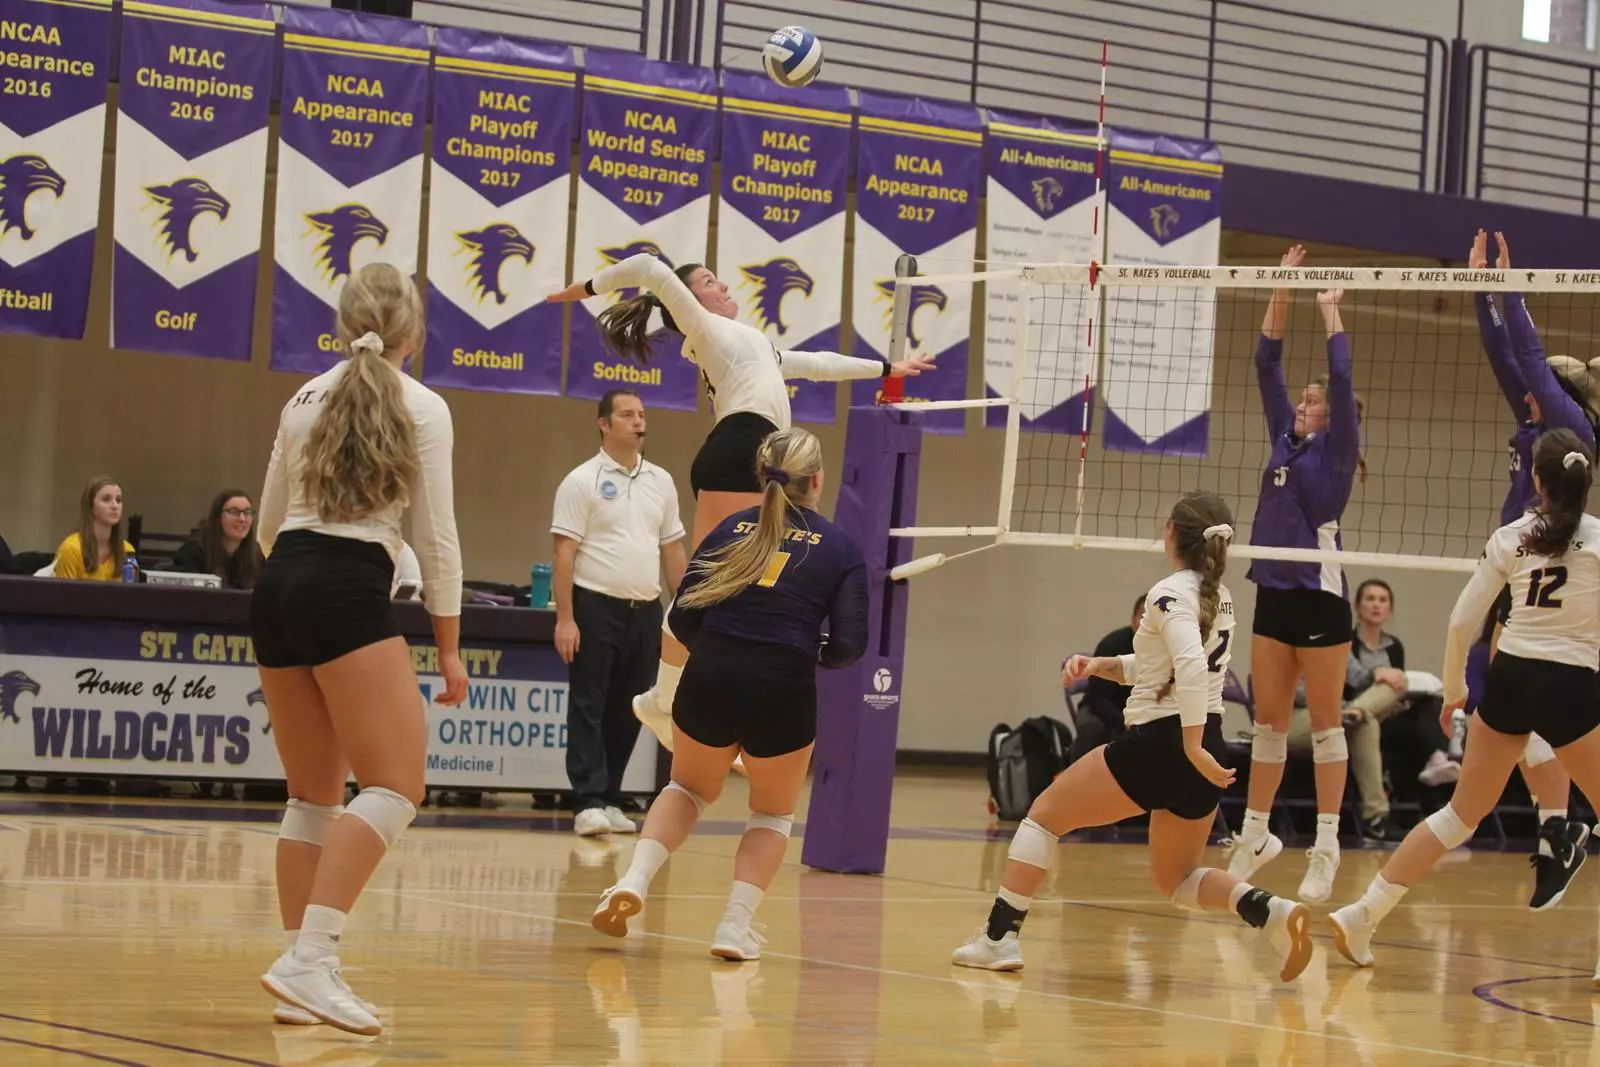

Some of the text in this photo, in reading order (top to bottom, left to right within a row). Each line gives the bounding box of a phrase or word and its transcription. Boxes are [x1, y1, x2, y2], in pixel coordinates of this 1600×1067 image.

[0, 20, 61, 46] NCAA
[169, 45, 225, 70] MIAC
[2, 77, 52, 98] 2016
[136, 67, 254, 101] Champions
[327, 74, 384, 98] NCAA
[170, 101, 215, 122] 2016
[293, 96, 413, 127] Appearance
[479, 90, 531, 113] MIAC
[469, 114, 538, 140] Playoff
[624, 110, 677, 134] NCAA
[330, 129, 374, 149] 2017
[587, 129, 706, 163] World Series
[761, 130, 810, 153] MIAC
[447, 137, 555, 167] Champions
[1000, 147, 1095, 174] All-Americans
[588, 155, 699, 187] Appearance
[753, 153, 817, 178] Playoff
[895, 154, 943, 176] NCAA
[480, 168, 521, 188] 2017
[731, 175, 833, 204] Champions
[866, 174, 968, 204] Appearance
[1119, 175, 1212, 201] All-Americans
[623, 187, 664, 207] 2017
[763, 205, 801, 224] 2017
[898, 204, 935, 223] 2017
[1133, 268, 1160, 279] KATE'S
[1164, 268, 1212, 279] VOLLEYBALL
[1271, 269, 1299, 280] KATE'S
[1304, 269, 1354, 281] VOLLEYBALL
[1401, 271, 1506, 284] ST. KATE'S VOLLEYBALL
[155, 309, 197, 331] Golf
[317, 333, 344, 352] Go
[452, 348, 524, 371] Softball
[593, 361, 662, 386] Softball
[1525, 565, 1568, 608] 12
[140, 631, 183, 660] ST.
[75, 668, 217, 705] Home of the
[455, 684, 569, 713] WIN CIT
[32, 706, 250, 765] WILDCATS
[427, 754, 494, 772] Medicine
